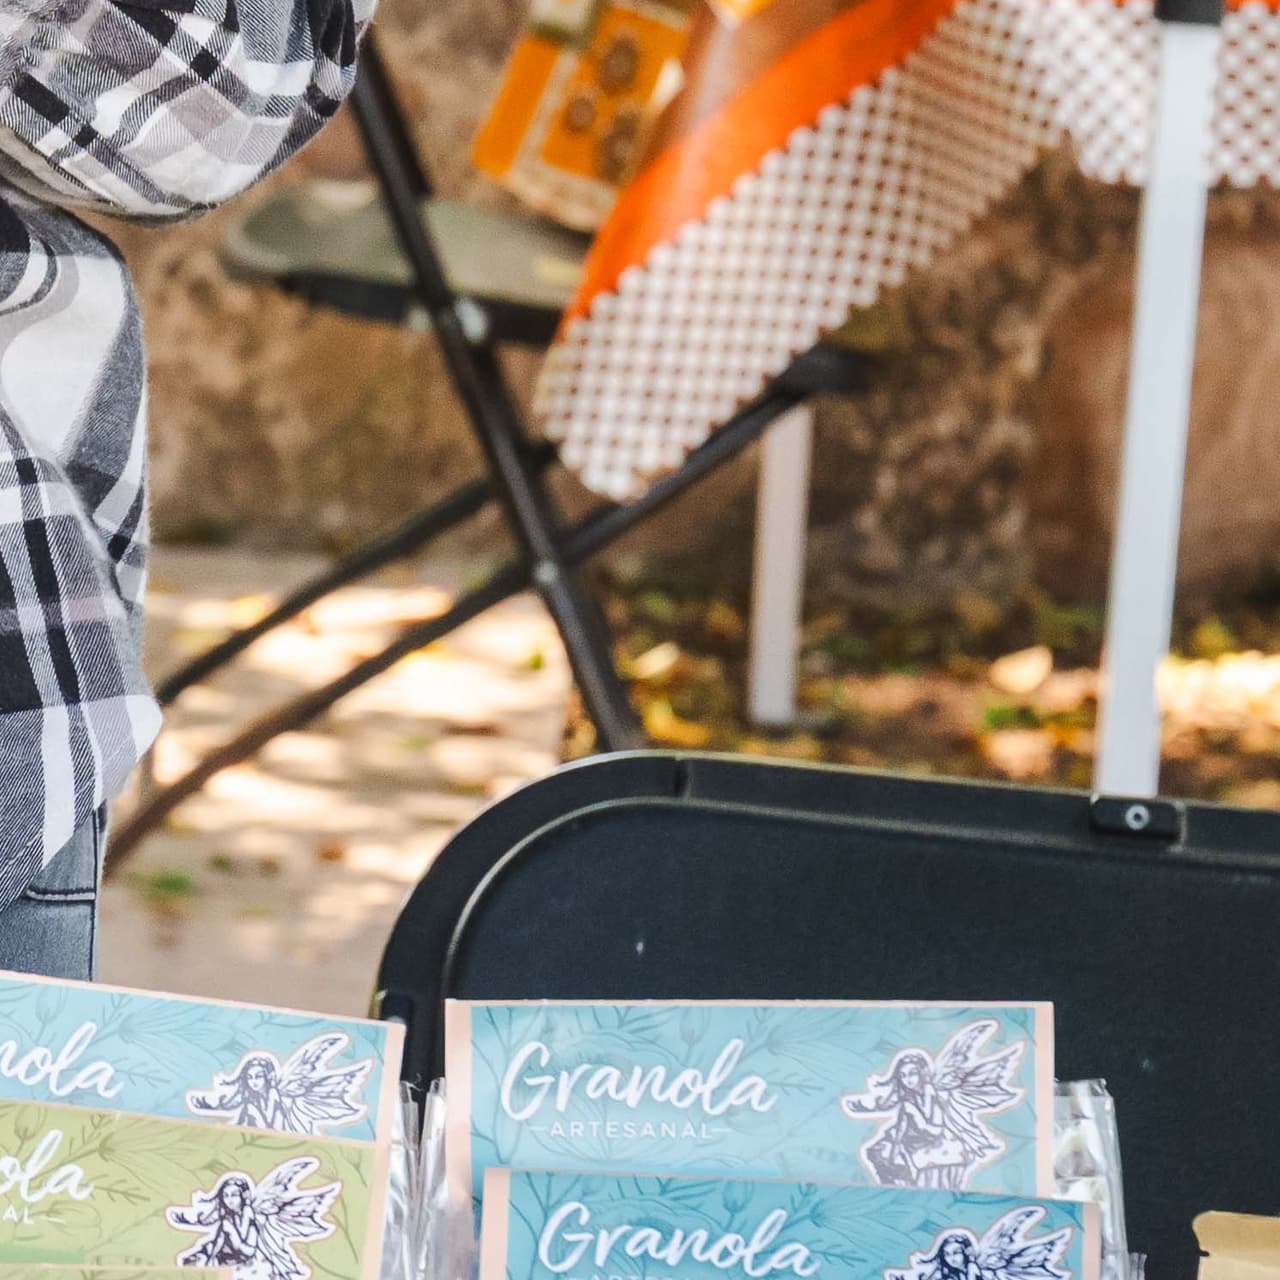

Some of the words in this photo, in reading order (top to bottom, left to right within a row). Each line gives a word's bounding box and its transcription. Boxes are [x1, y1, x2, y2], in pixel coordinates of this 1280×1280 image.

[500, 1038, 779, 1121] Granola
[550, 1120, 713, 1139] ARTESANAL
[538, 1201, 822, 1277] Granola
